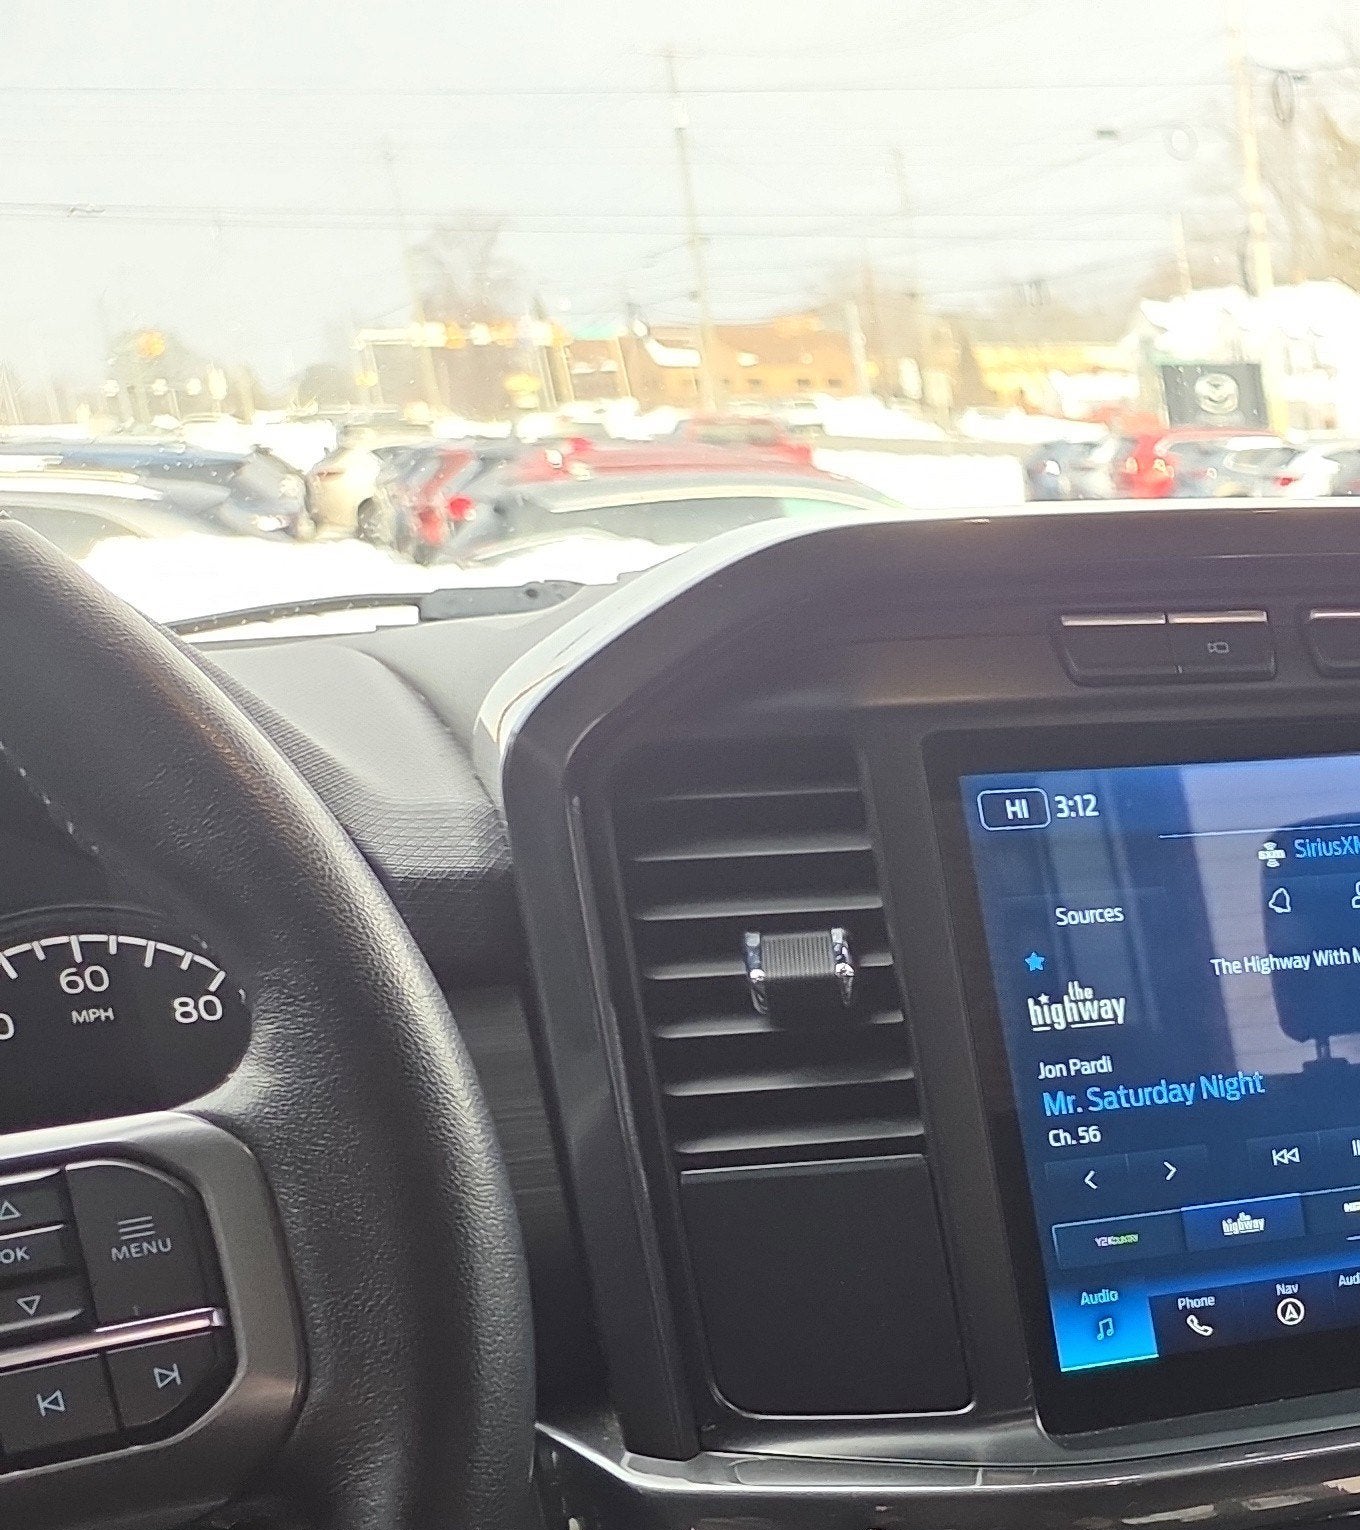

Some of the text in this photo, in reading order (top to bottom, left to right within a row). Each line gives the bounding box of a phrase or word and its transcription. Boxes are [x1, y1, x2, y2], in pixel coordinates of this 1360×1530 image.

[1004, 799, 1030, 819] HI
[1056, 794, 1100, 819] 3:12
[1055, 904, 1124, 926] Sources
[1211, 957, 1242, 977] The
[1243, 953, 1311, 976] Highway
[1312, 948, 1350, 968] With
[59, 964, 111, 995] 60
[1068, 980, 1093, 1000] the
[71, 1006, 115, 1025] MPH
[172, 994, 224, 1025] 80
[1027, 994, 1126, 1031] highway
[1037, 1055, 1113, 1080] Jon Pardi
[1043, 1070, 1266, 1117] Mr. Saturday Night
[1047, 1125, 1102, 1148] Ch. 56
[0, 1246, 31, 1264] OK
[111, 1236, 173, 1263] MENU
[1080, 1288, 1119, 1306] Audio
[1275, 1281, 1299, 1297] Nav
[1177, 1293, 1216, 1311] Phone
